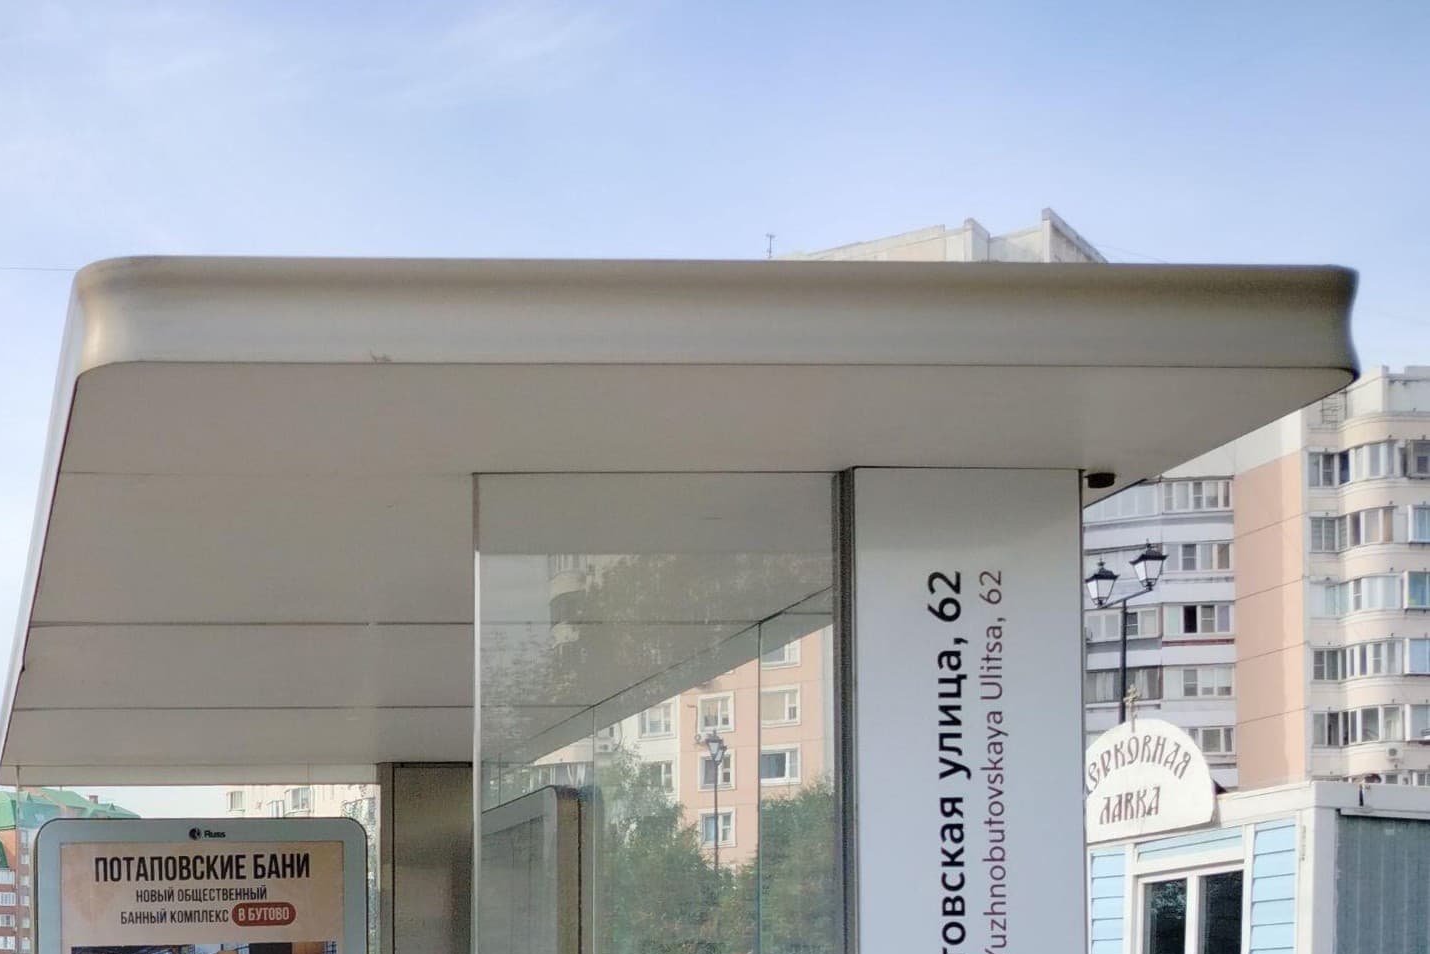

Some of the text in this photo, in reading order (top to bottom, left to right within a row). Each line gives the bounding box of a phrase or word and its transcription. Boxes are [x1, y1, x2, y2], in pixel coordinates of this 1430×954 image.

[927, 570, 962, 623] 62
[979, 570, 1002, 605] 62
[979, 617, 1006, 700] Ulitsa,
[937, 637, 972, 780] улица,
[1085, 734, 1191, 795] ЕРКОВНАЯ
[1099, 786, 1161, 825] ЛАВКА
[204, 830, 226, 839] Russ
[95, 853, 310, 882] ПОТАПОВСКИЕ БАНИ
[136, 885, 268, 903] НОВЫЙ ОБЩЕСТВЕННЫЙ
[121, 907, 290, 925] БАННЫЙ КОМПЛЕКС В БУТОВО
